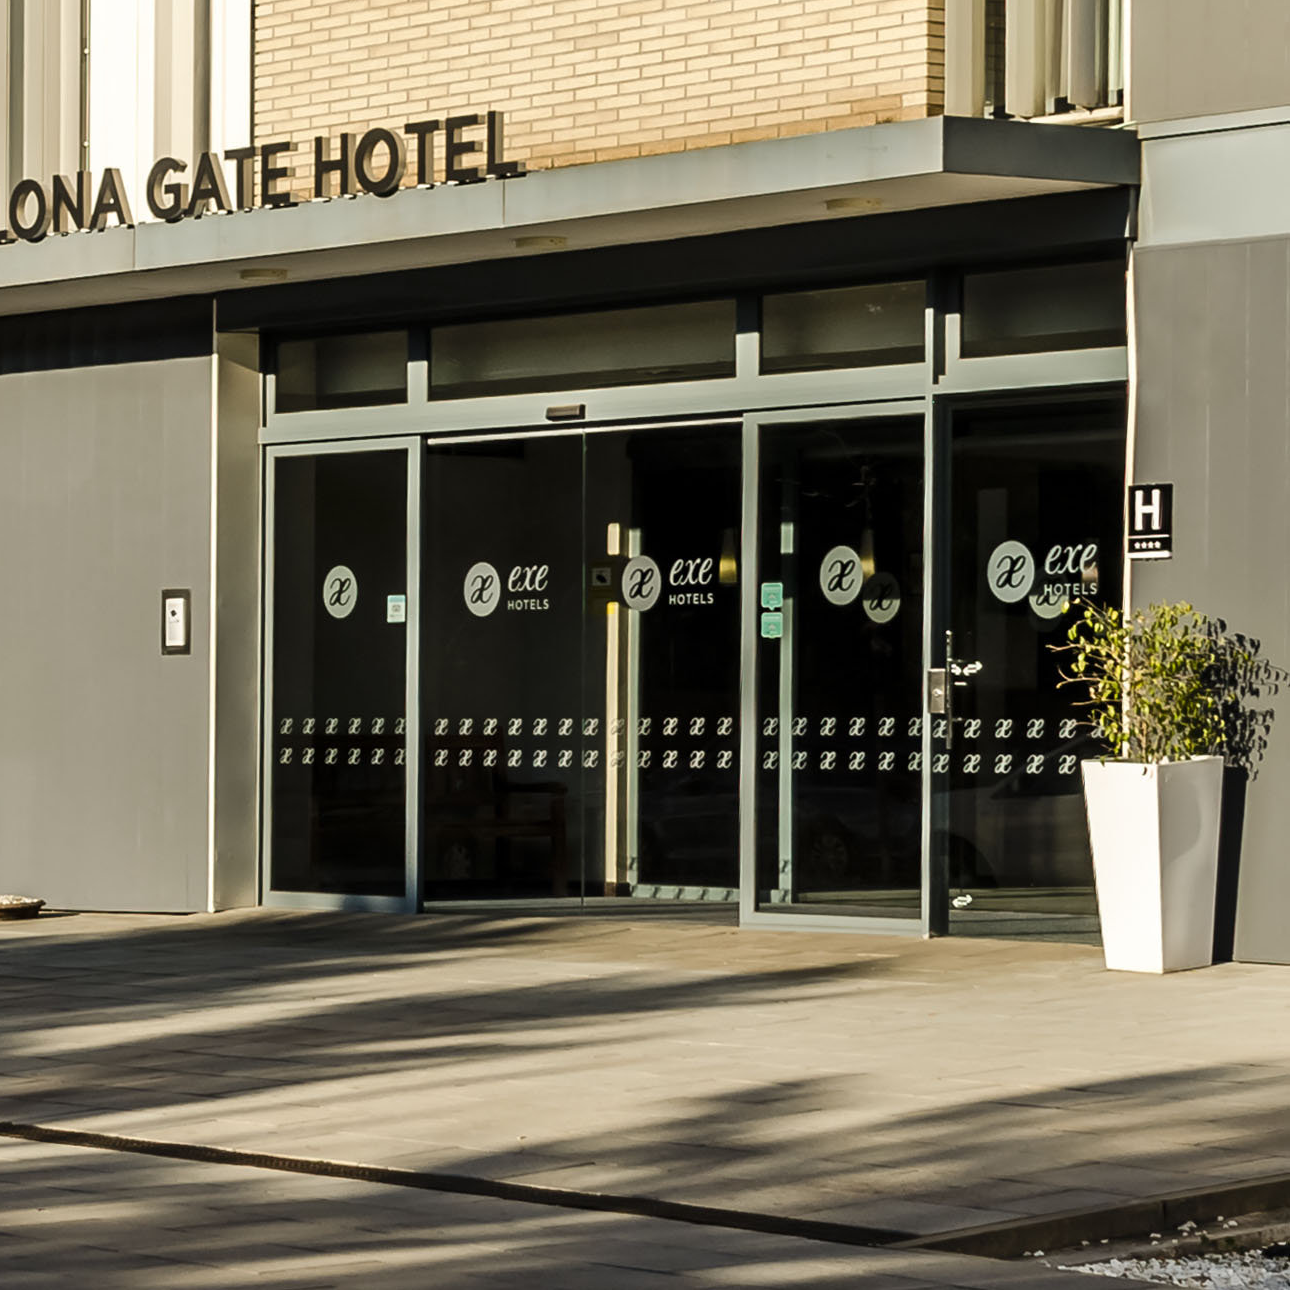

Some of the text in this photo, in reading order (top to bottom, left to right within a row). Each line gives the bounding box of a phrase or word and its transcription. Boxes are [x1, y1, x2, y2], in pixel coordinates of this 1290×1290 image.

[146, 141, 299, 223] GATE
[314, 110, 527, 198] HOTEL
[1133, 489, 1161, 531] H
[670, 557, 713, 586] exe
[1044, 543, 1098, 575] exe
[507, 564, 549, 592] exe
[1043, 582, 1097, 596] HOTELS
[507, 598, 550, 610] HOTELS
[669, 592, 714, 605] HOTELS
